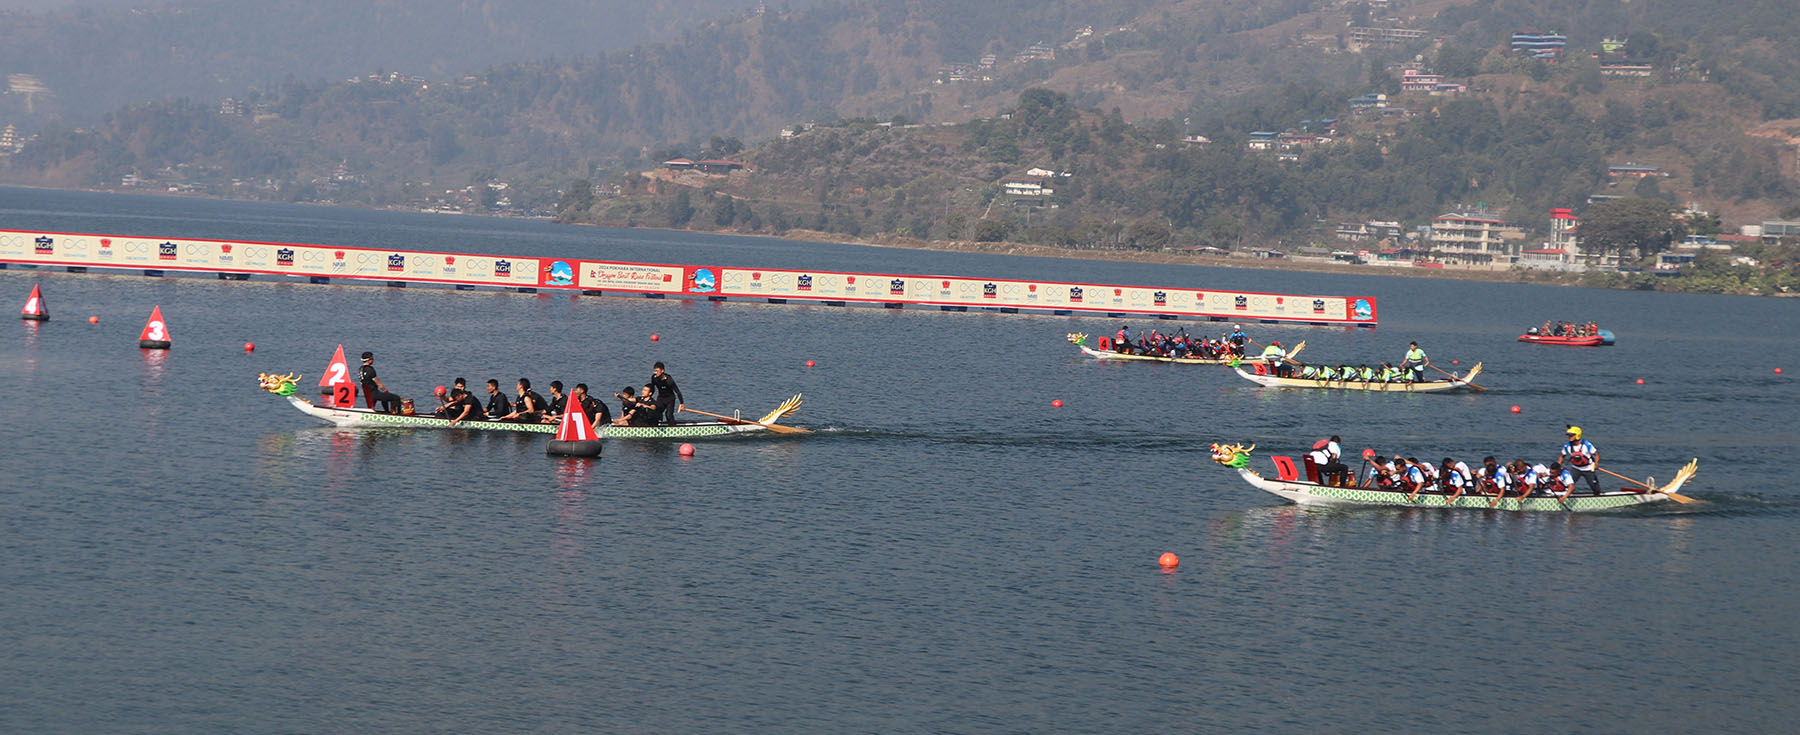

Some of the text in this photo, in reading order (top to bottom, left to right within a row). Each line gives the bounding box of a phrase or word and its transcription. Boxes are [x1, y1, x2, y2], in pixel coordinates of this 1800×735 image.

[25, 298, 38, 314] 4
[148, 320, 164, 340] 3
[328, 362, 346, 386] 2
[339, 387, 350, 404] 2
[572, 412, 587, 440] 1
[1280, 460, 1291, 476] 1
